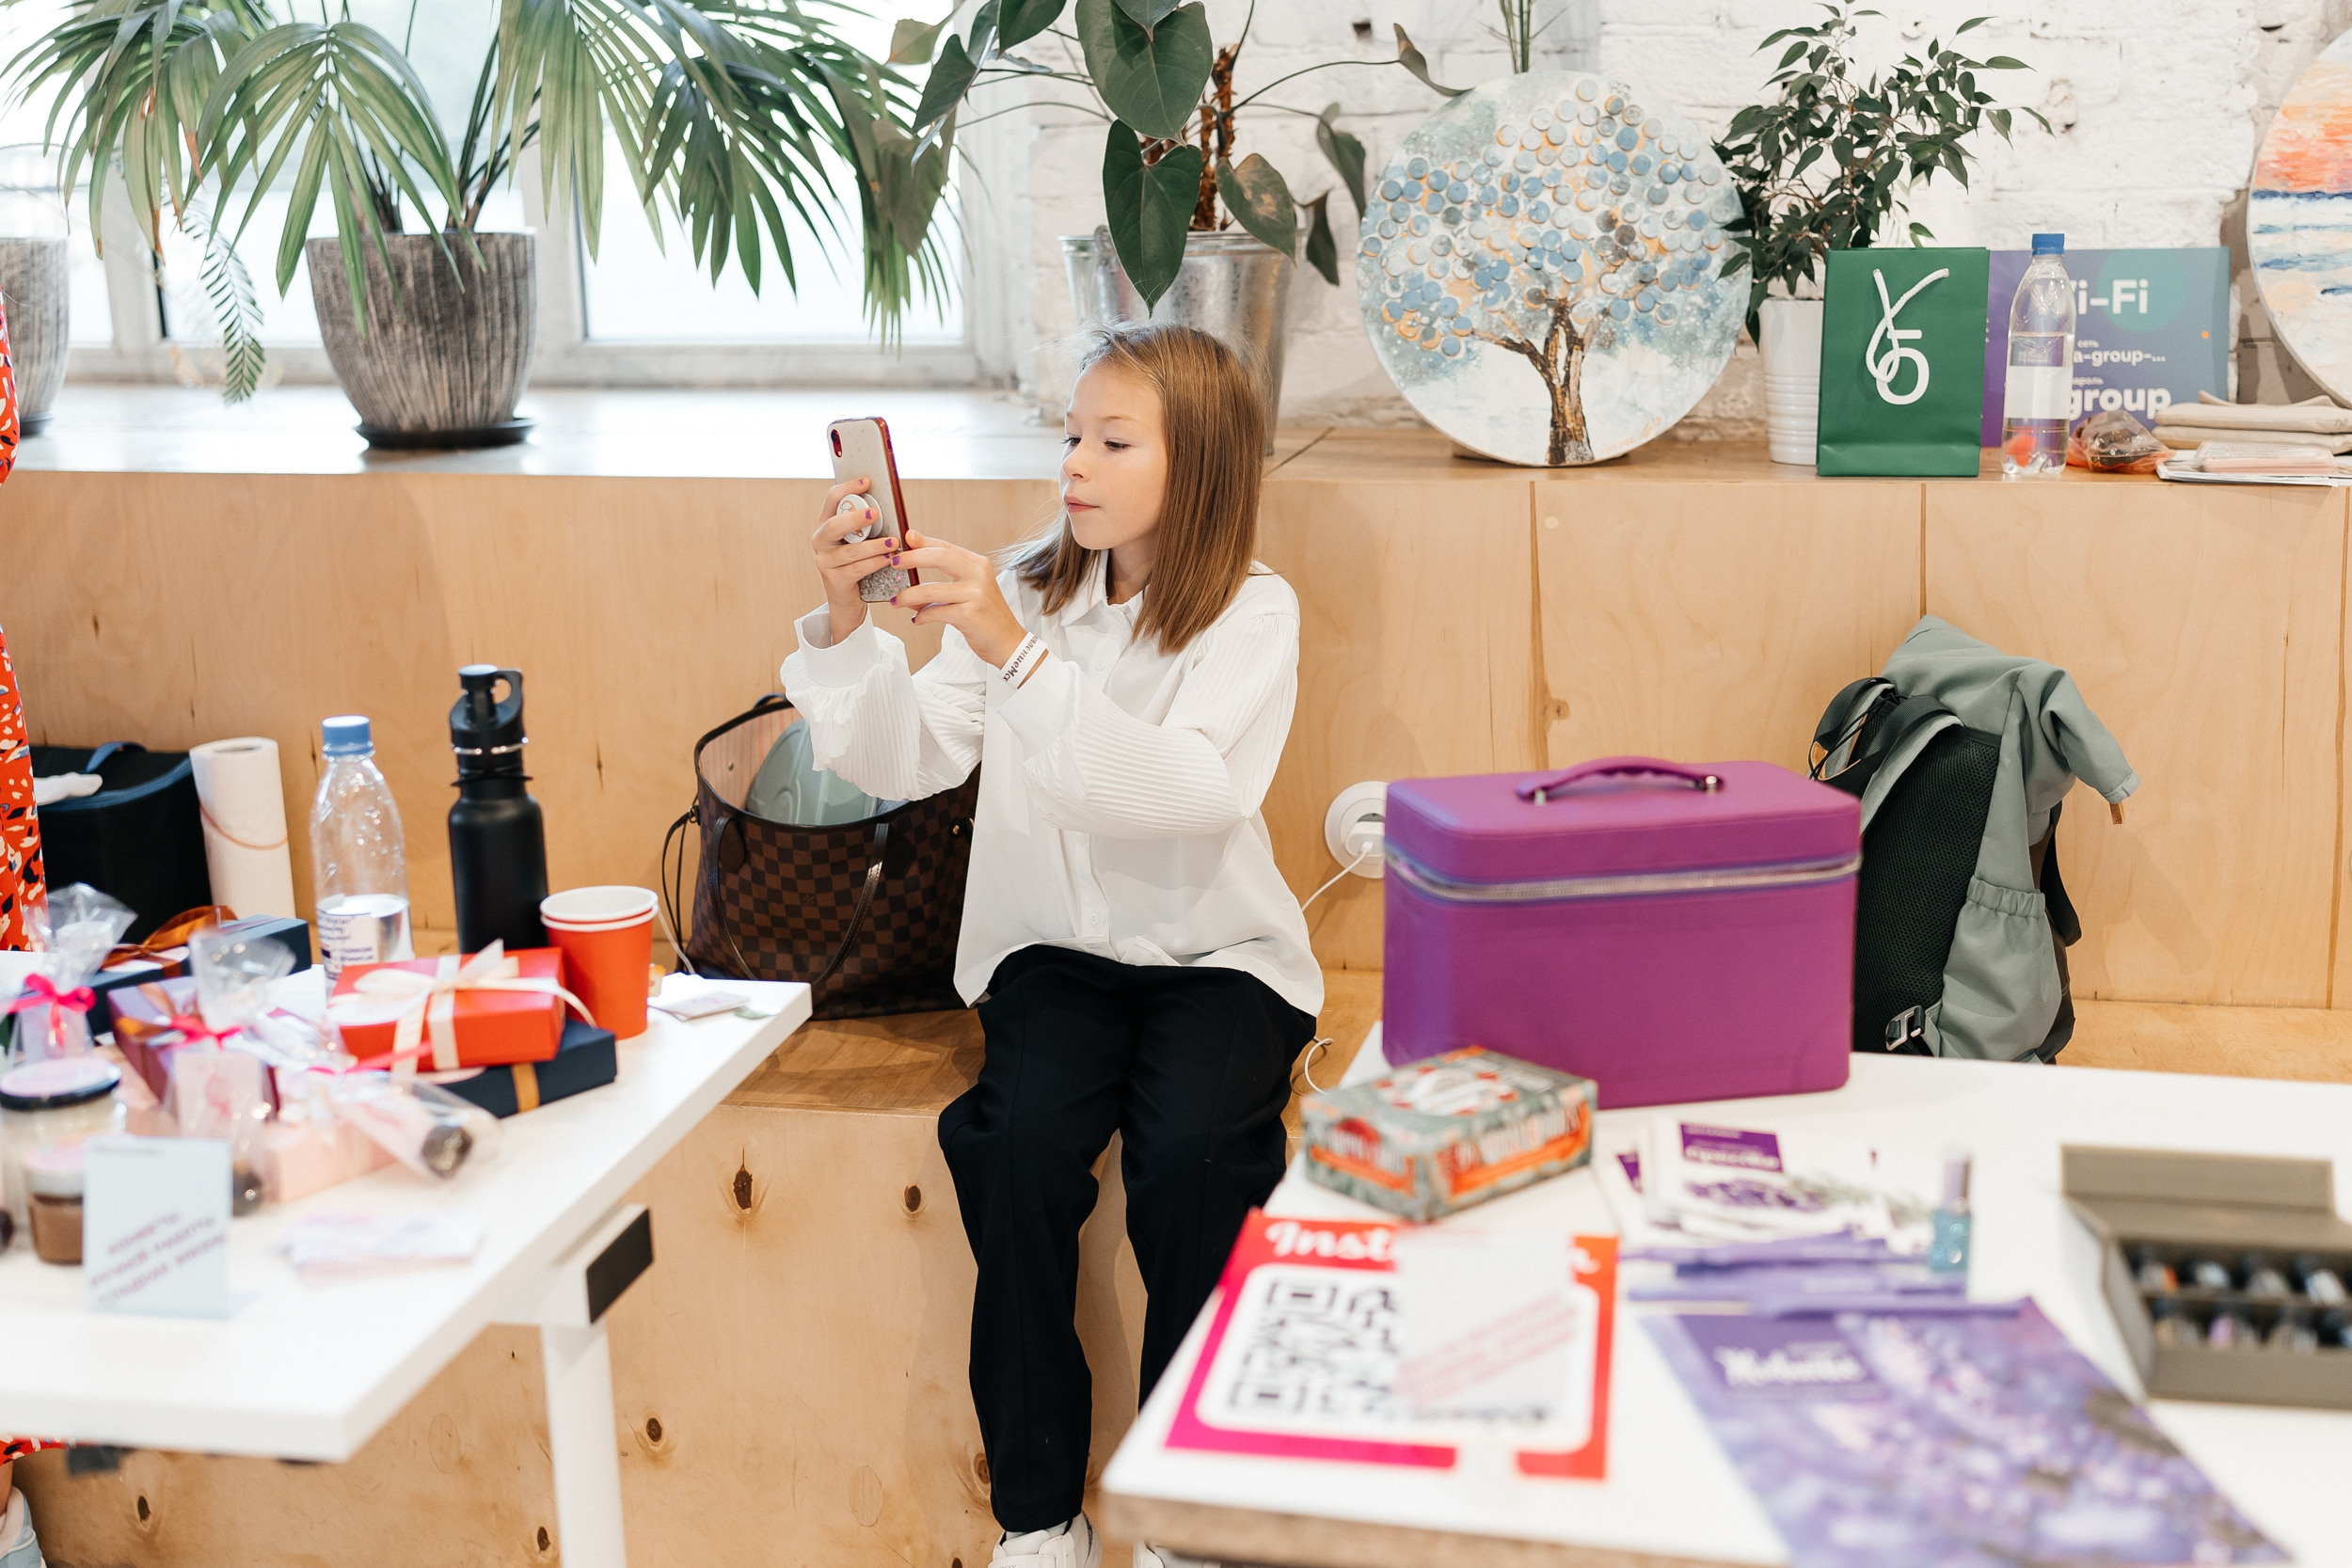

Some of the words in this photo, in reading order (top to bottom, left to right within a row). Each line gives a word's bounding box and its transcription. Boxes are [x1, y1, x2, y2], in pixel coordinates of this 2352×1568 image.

[2071, 278, 2149, 315] i-Fi
[2073, 349, 2167, 367] a-group-...
[2073, 376, 2105, 387] ароль
[2069, 387, 2172, 421] group
[1265, 1220, 1394, 1261] Inst
